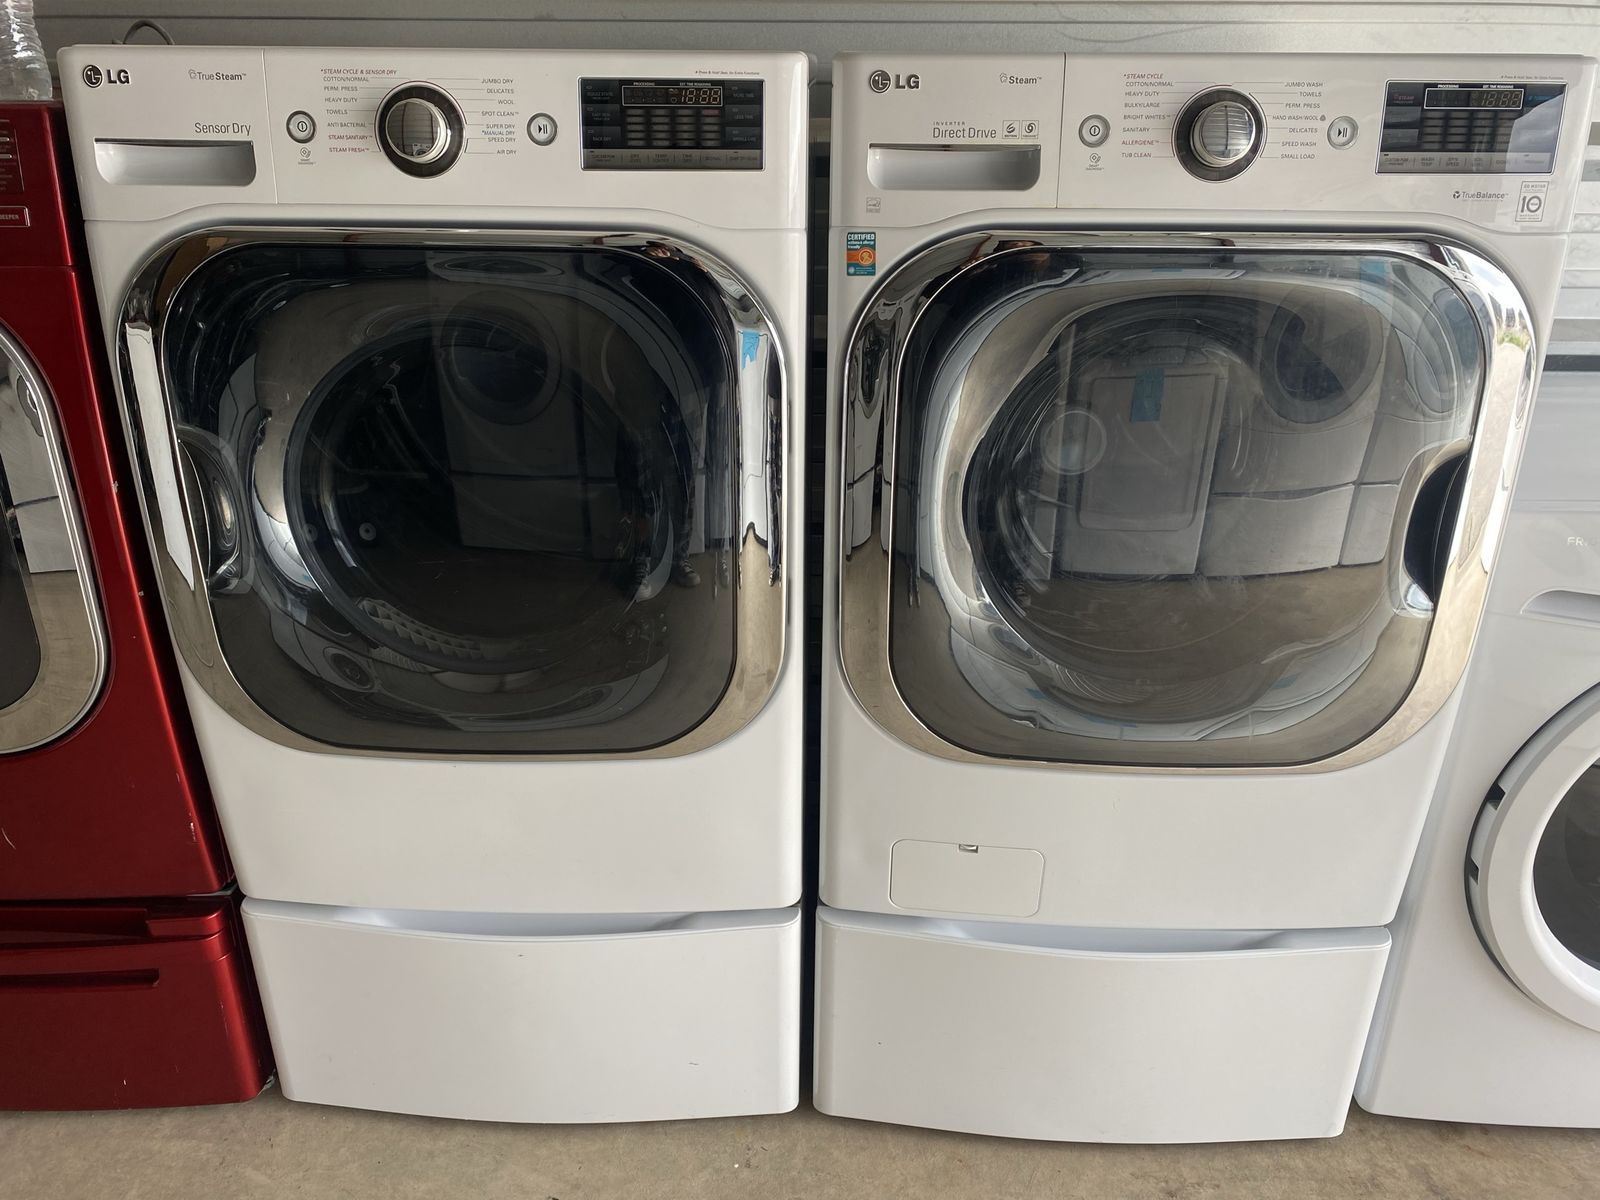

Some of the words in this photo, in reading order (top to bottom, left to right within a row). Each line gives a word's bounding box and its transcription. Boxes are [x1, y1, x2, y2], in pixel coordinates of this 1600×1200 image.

[107, 69, 131, 85] LG
[894, 73, 920, 90] LG
[194, 122, 230, 134] Sensor
[232, 122, 251, 137] Dry
[932, 127, 966, 139] Direct
[968, 127, 997, 139] Drive
[1520, 195, 1542, 214] 10
